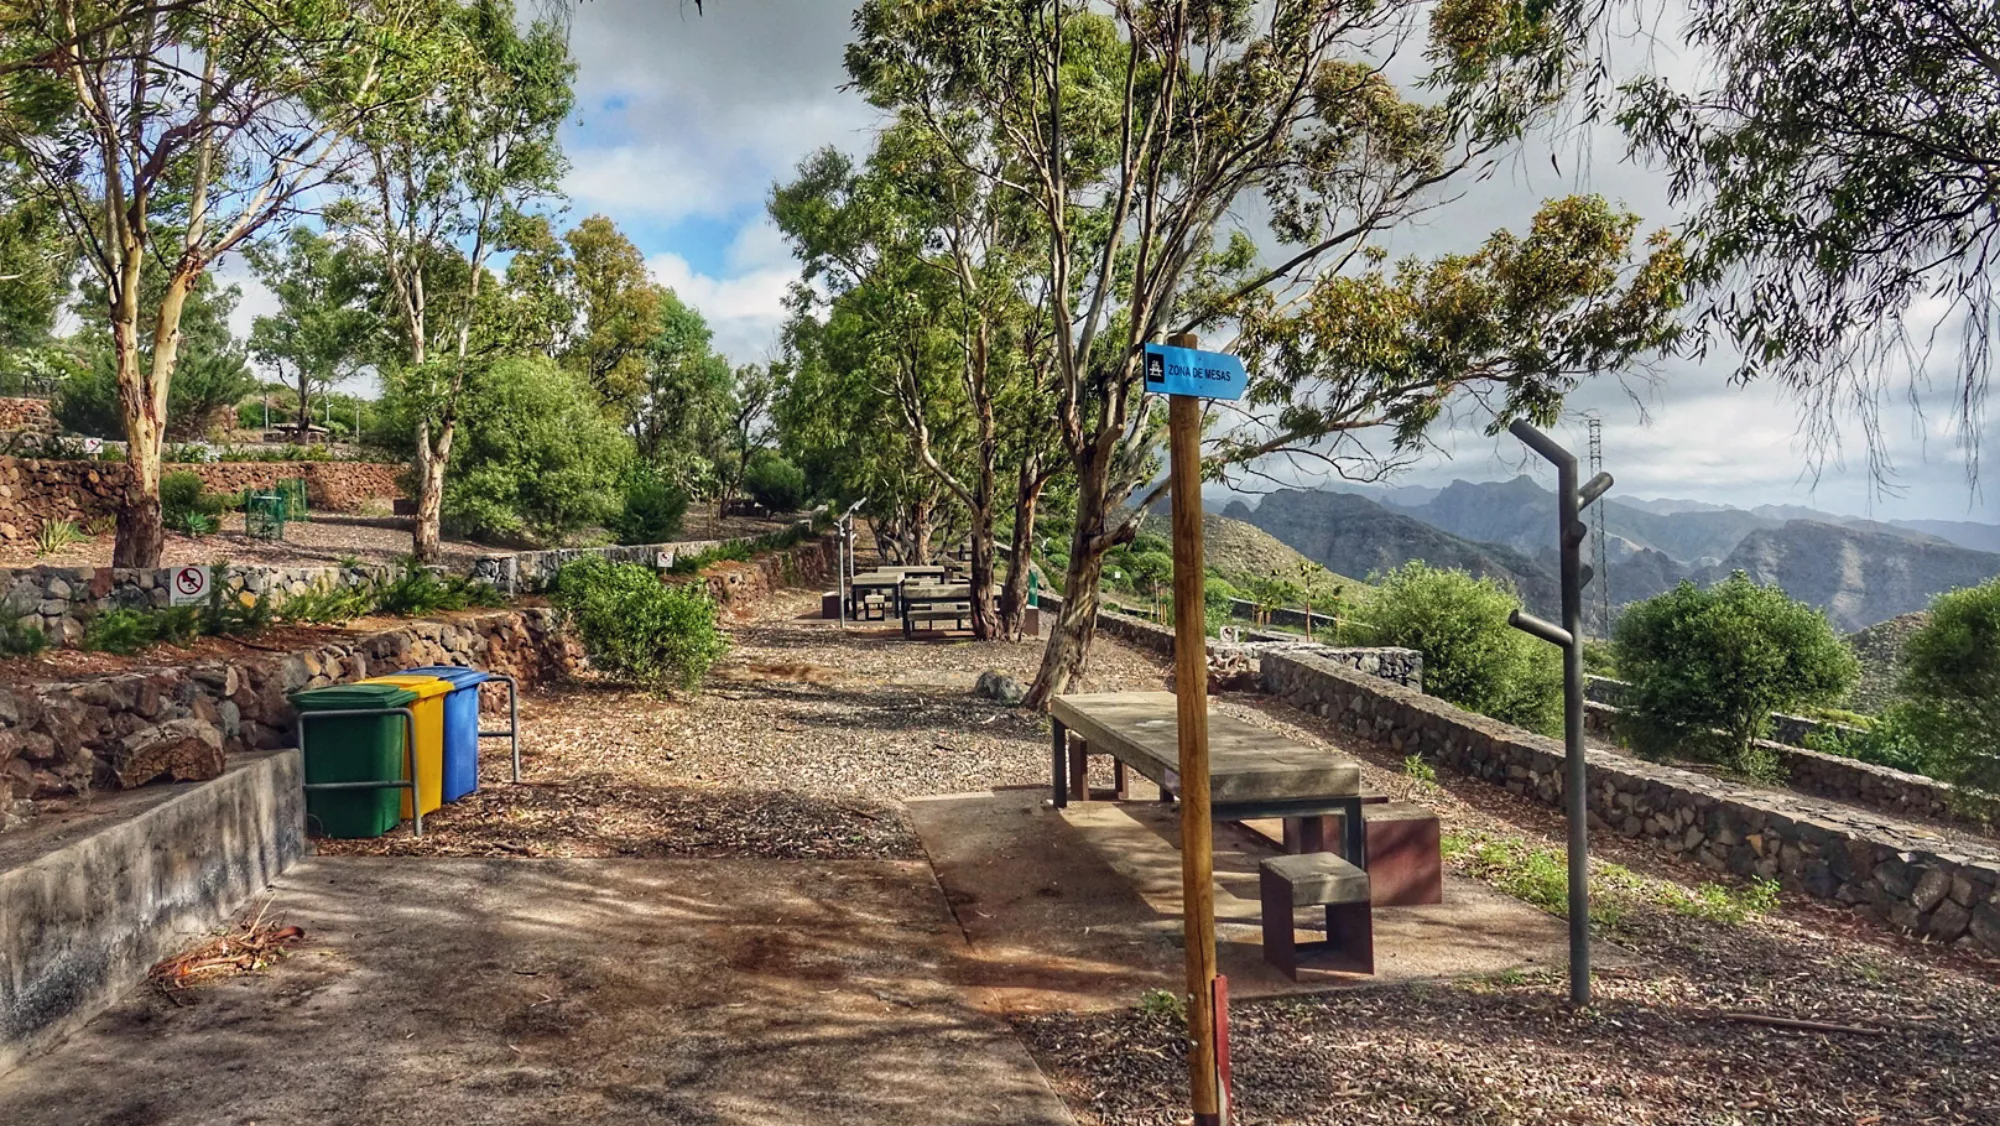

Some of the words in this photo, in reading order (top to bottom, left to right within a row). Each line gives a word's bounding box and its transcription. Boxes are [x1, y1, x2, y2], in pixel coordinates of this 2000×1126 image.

[1168, 364, 1190, 376] ZONA
[1192, 367, 1203, 379] DE
[1205, 369, 1231, 381] MESAS
